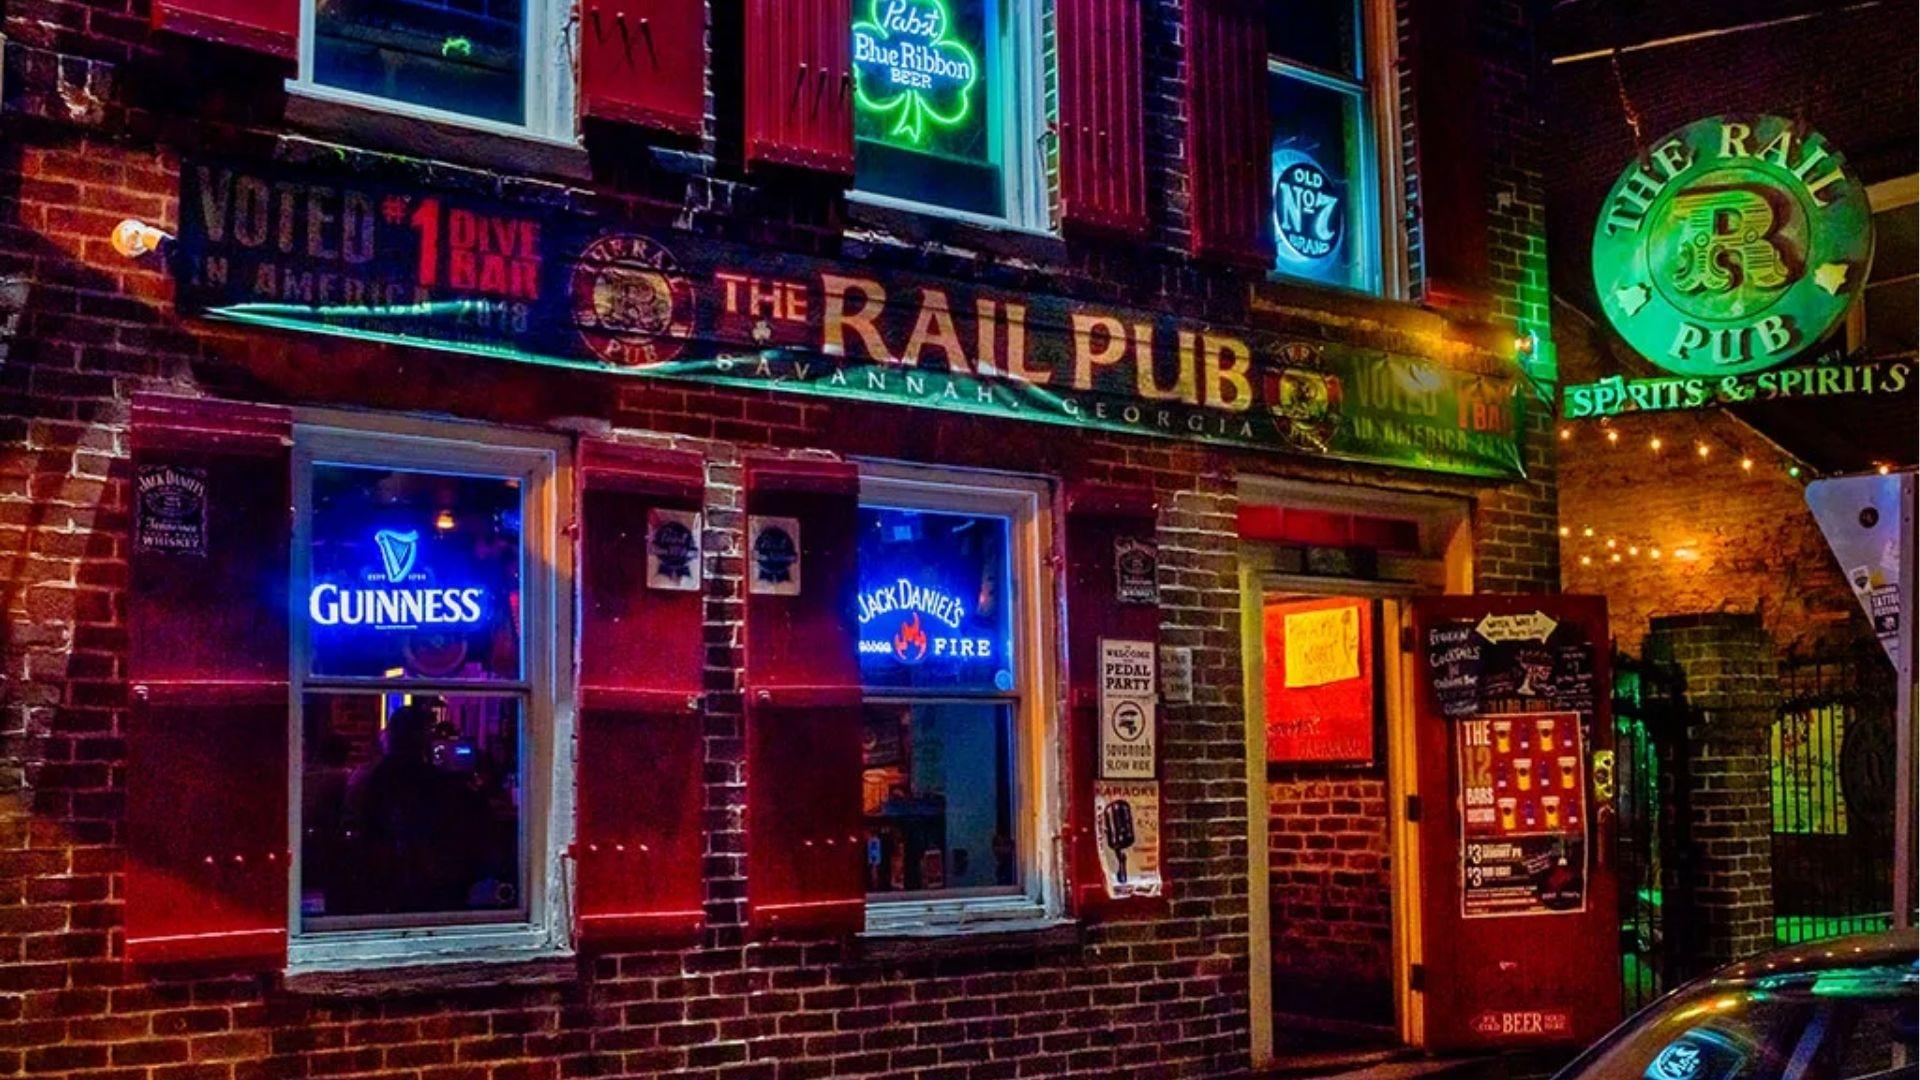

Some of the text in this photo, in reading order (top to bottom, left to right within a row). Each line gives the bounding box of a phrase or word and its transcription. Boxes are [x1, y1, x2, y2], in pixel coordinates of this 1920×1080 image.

[884, 0, 939, 38] Pabst
[854, 33, 970, 80] Blue Ribbon
[891, 67, 932, 88] BEER
[1294, 168, 1322, 188] OLD
[1604, 123, 1846, 237] THE RAIL
[198, 166, 377, 265] VOTED
[449, 207, 542, 259] DIVE
[449, 250, 540, 301] BAR
[604, 338, 659, 363] PUB
[715, 272, 1252, 412] THE RAIL PUB
[1667, 314, 1792, 364] PUB
[1720, 376, 1747, 402] &
[1757, 362, 1911, 399] SPIRITS
[1062, 398, 1253, 439] GEORGIA
[309, 583, 482, 625] GUINNESS
[858, 578, 965, 629] JACK DANIEL'S
[934, 637, 991, 657] FIRE
[1106, 648, 1151, 660] WELCOME
[1106, 663, 1152, 677] PEDAL
[1106, 677, 1151, 691] PARTY
[1463, 720, 1492, 747] THE
[1466, 747, 1493, 788] 12
[1502, 1011, 1543, 1034] BEER
